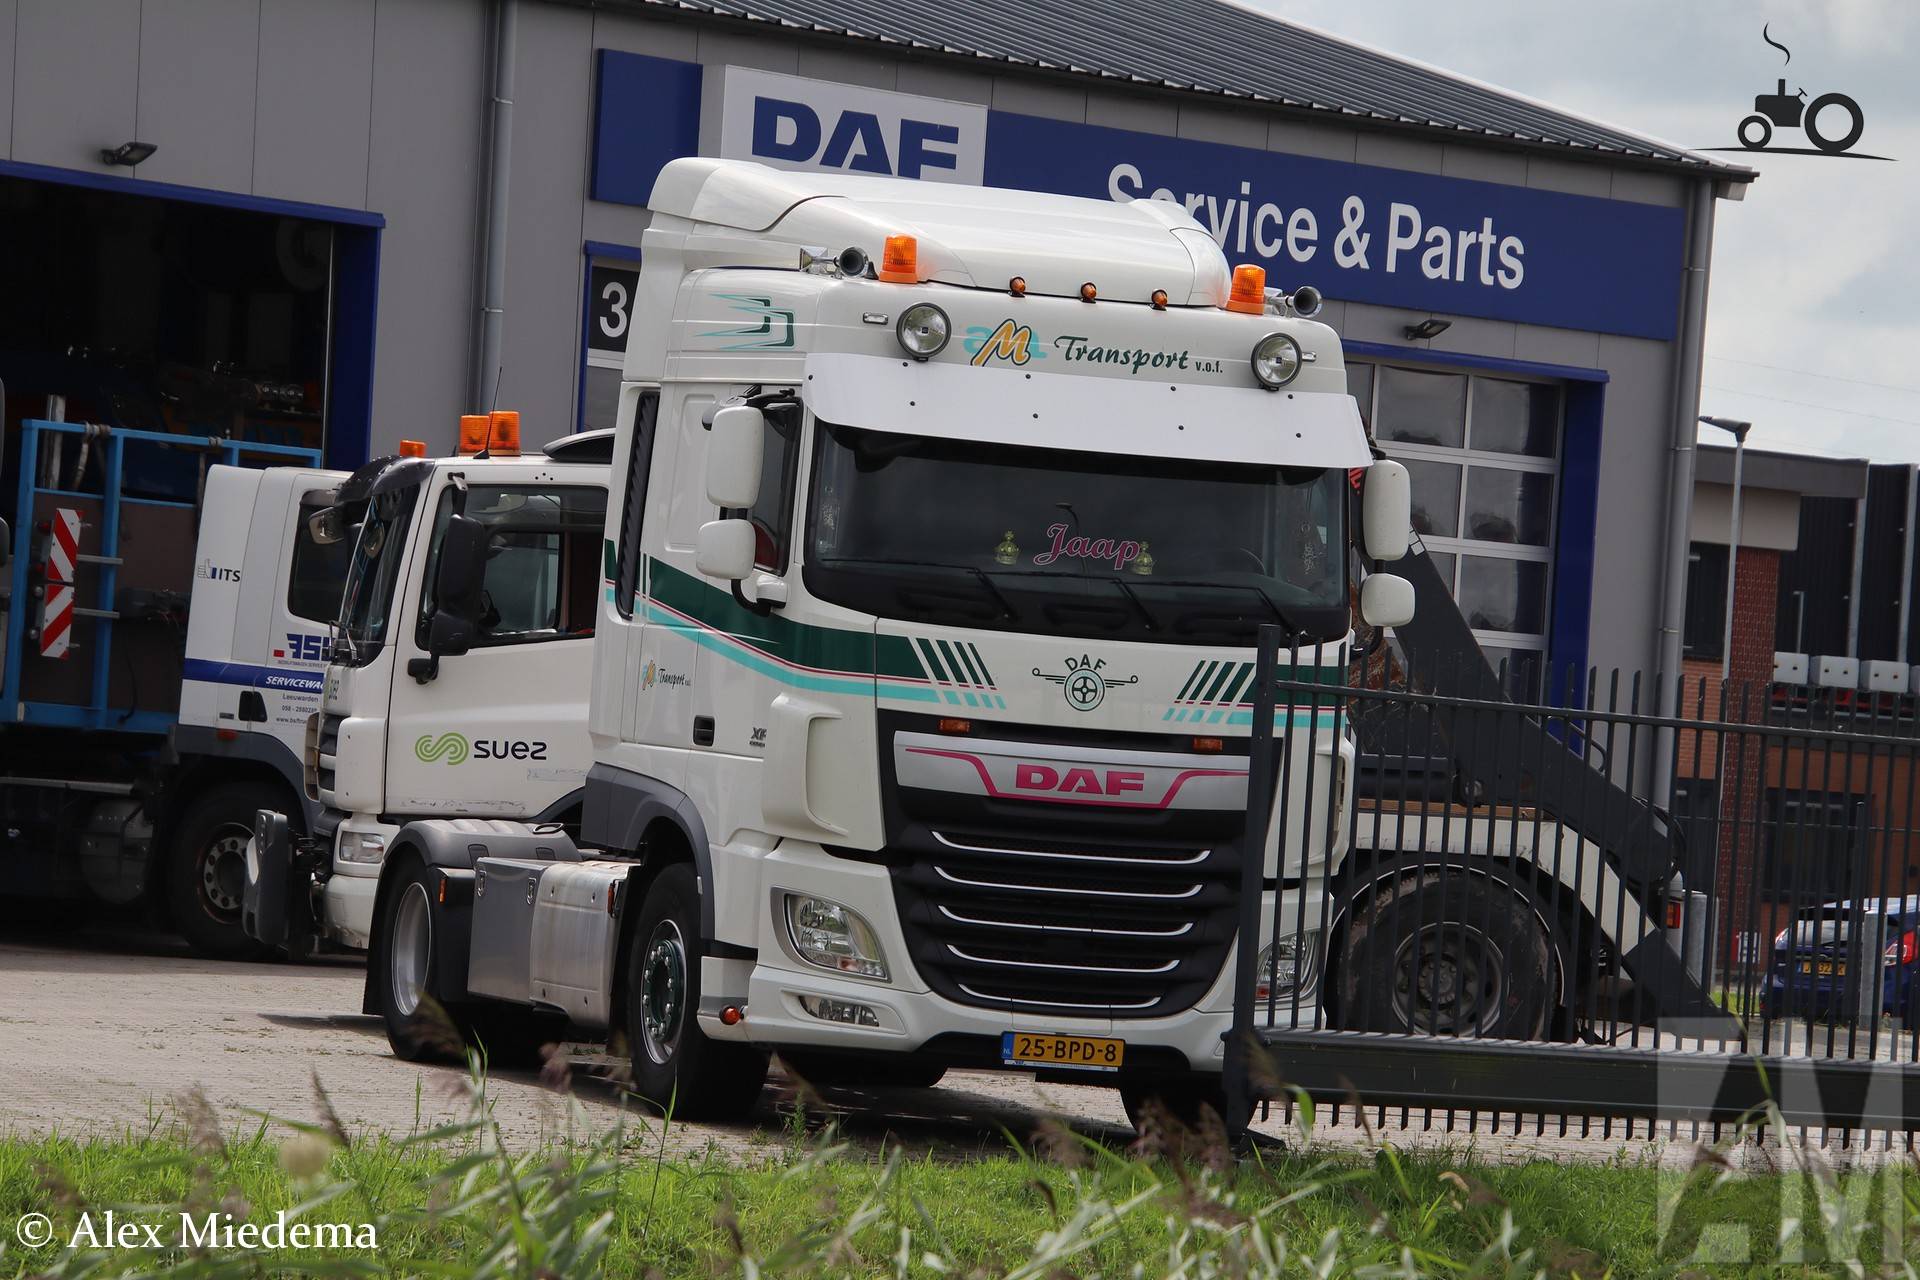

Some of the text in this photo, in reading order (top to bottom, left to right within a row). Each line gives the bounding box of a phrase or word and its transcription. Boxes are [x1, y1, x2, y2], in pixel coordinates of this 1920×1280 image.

[752, 96, 959, 180] DAF
[1108, 163, 1525, 290] Srvice & Parts
[599, 281, 628, 338] 3
[1053, 335, 1189, 374] Transport
[1195, 361, 1224, 374] v.o.f.
[1033, 523, 1141, 571] Jaap
[218, 568, 241, 582] ITS
[659, 668, 686, 689] Transport
[1064, 653, 1107, 671] DAF
[1016, 764, 1145, 795] DAF
[1019, 1038, 1117, 1062] 25-BPD-8
